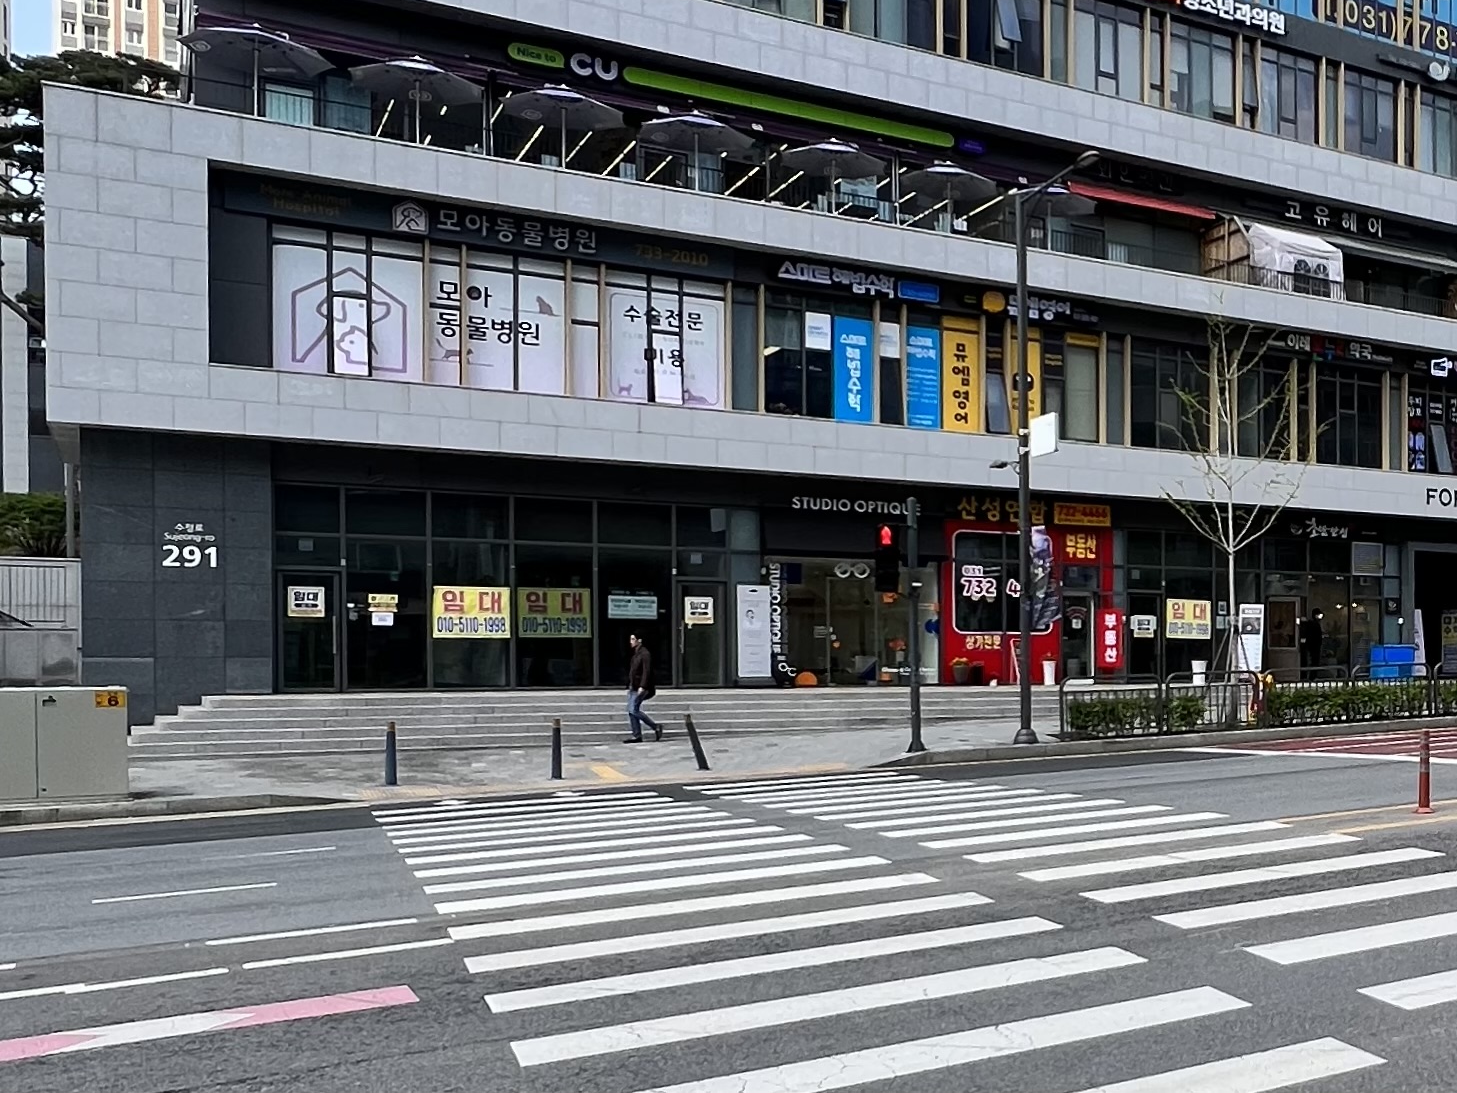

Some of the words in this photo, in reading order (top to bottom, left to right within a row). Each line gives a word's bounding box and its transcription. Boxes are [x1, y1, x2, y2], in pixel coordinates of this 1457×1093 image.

[515, 45, 541, 61] Nice
[544, 52, 557, 63] to
[569, 51, 619, 82] CU
[437, 208, 597, 254] 모아동물병원
[1285, 199, 1383, 239] 고유헤어
[436, 280, 492, 308] 모아
[436, 311, 541, 347] 동물병원
[792, 495, 851, 512] STUDIO
[174, 522, 204, 533] 수정로
[161, 544, 219, 568] 291
[1066, 533, 1097, 559] 부동산
[440, 590, 503, 615] 임대
[525, 590, 583, 615] 임대
[1172, 601, 1208, 620] 임대
[1104, 612, 1118, 663] 부동산
